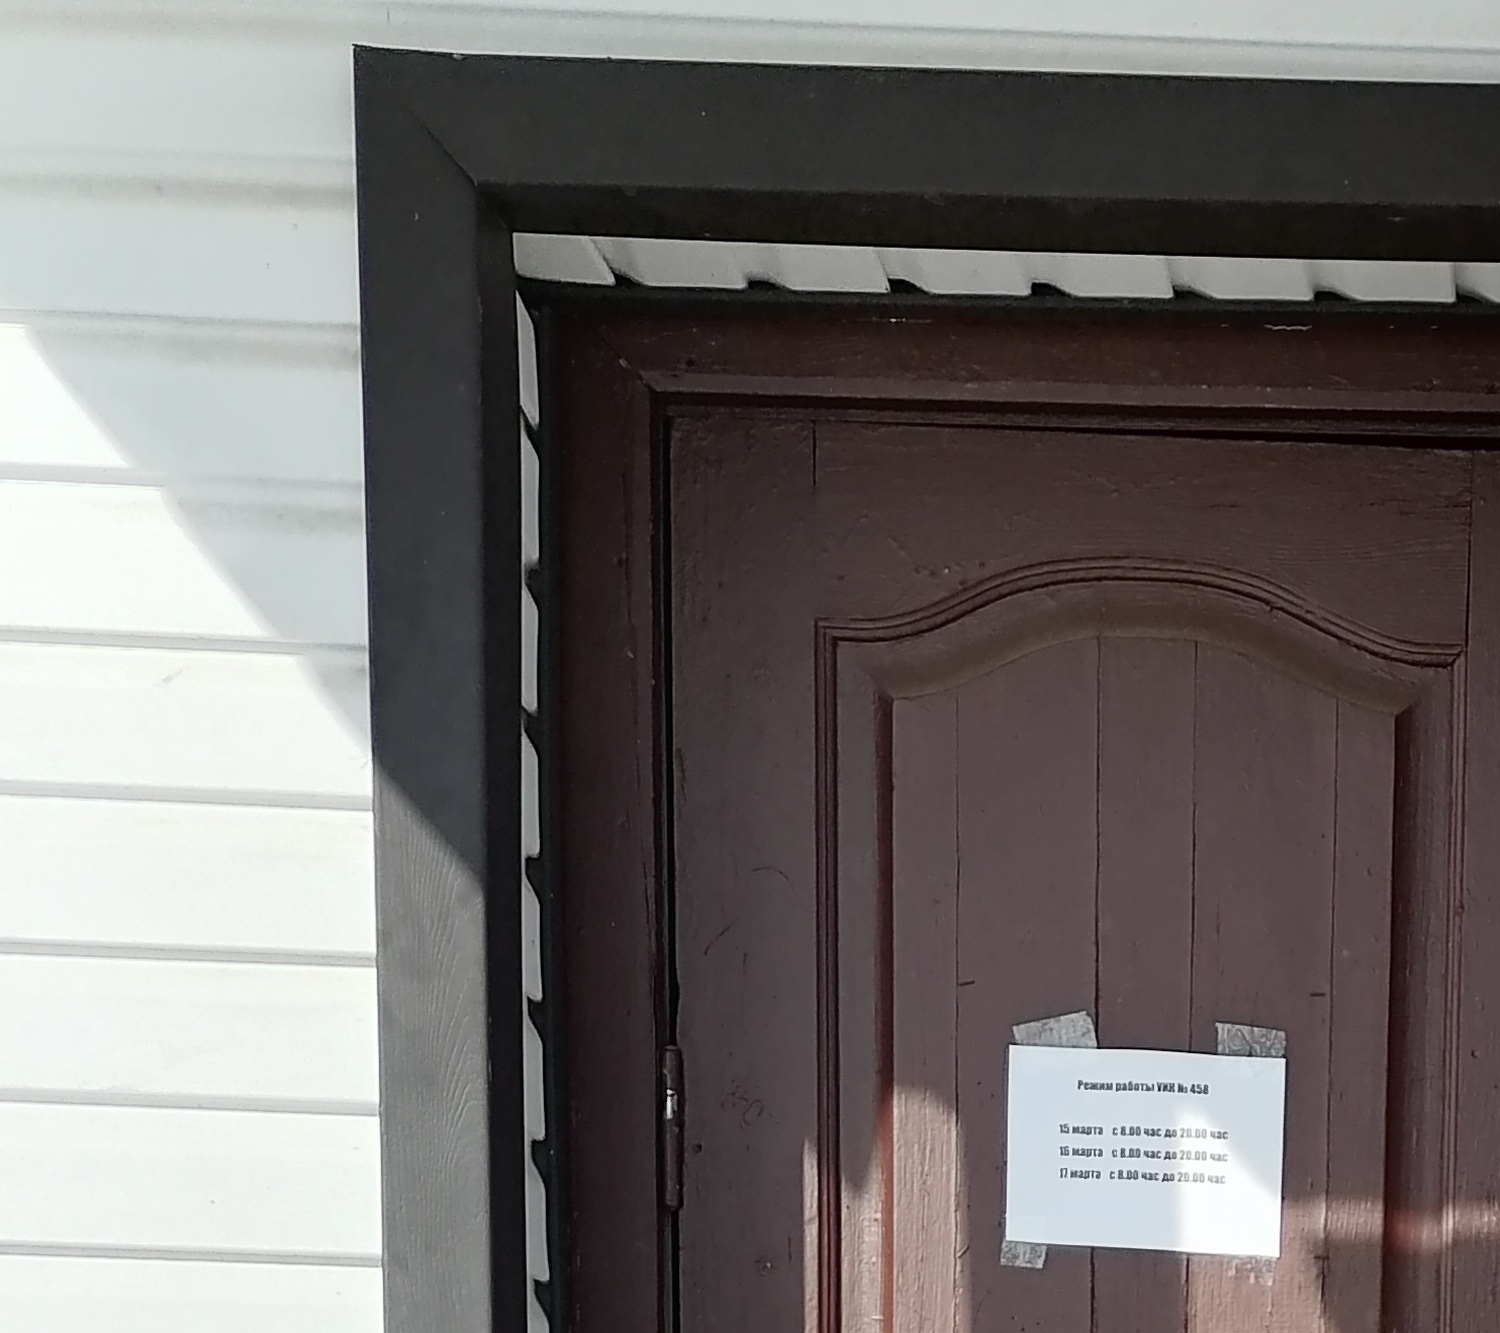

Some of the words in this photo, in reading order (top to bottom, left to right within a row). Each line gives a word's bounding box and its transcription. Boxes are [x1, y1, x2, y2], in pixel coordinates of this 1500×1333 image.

[1078, 1080, 1113, 1090] Режим
[1116, 1081, 1154, 1092] работы
[1157, 1082, 1175, 1093] УИК
[1190, 1084, 1209, 1094] 458
[1059, 1124, 1069, 1134] 15
[1072, 1126, 1103, 1135] марта
[1112, 1127, 1118, 1136] с
[1120, 1126, 1141, 1136] 8.00
[1144, 1128, 1161, 1137] час
[1164, 1128, 1177, 1139] до
[1180, 1128, 1207, 1138] 20.00
[1210, 1131, 1228, 1139] час
[1059, 1146, 1069, 1156] 16
[1072, 1148, 1103, 1157] марта
[1144, 1150, 1161, 1159] час
[1164, 1150, 1177, 1161] до
[1180, 1150, 1207, 1161] 20.00
[1210, 1153, 1228, 1162] час
[1060, 1168, 1068, 1178] 17
[1070, 1170, 1101, 1179] марта
[1110, 1171, 1115, 1179] с
[1118, 1170, 1138, 1180] 8.00
[1141, 1172, 1159, 1181] час
[1162, 1173, 1174, 1183] до
[1177, 1172, 1205, 1183] 20.00
[1208, 1174, 1226, 1184] час
